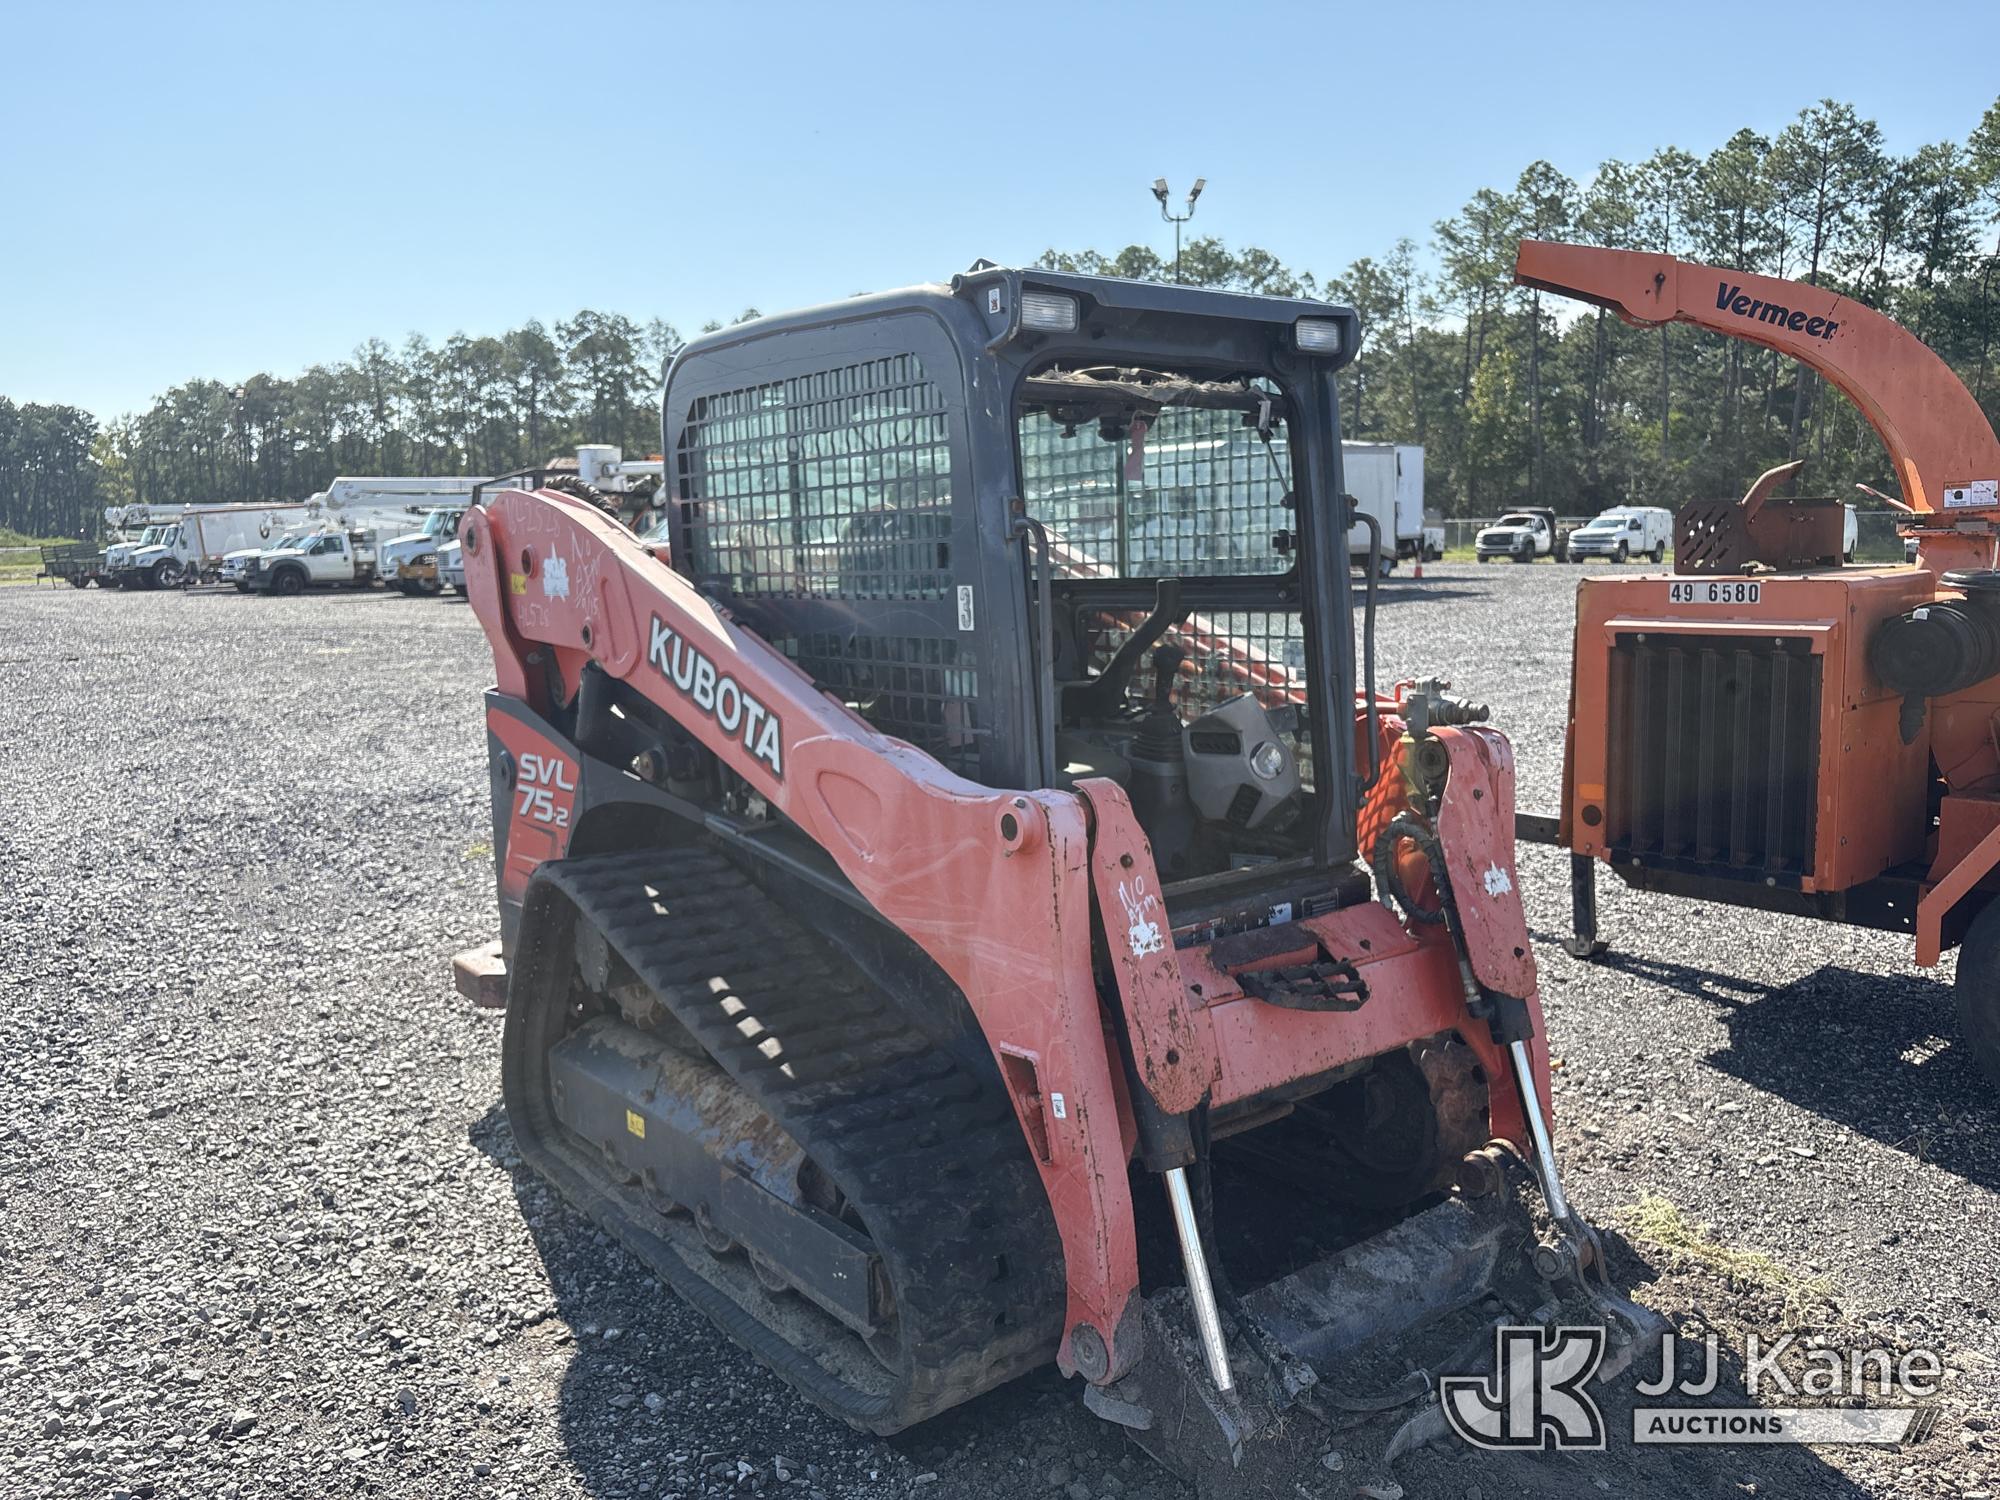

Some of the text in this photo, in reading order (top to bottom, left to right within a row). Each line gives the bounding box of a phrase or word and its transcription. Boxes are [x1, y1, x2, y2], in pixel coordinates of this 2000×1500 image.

[1716, 282, 1839, 340] Vermeer
[1671, 583, 1759, 603] 49 6580
[649, 616, 781, 774] KUBOTA
[519, 752, 575, 792] SVL
